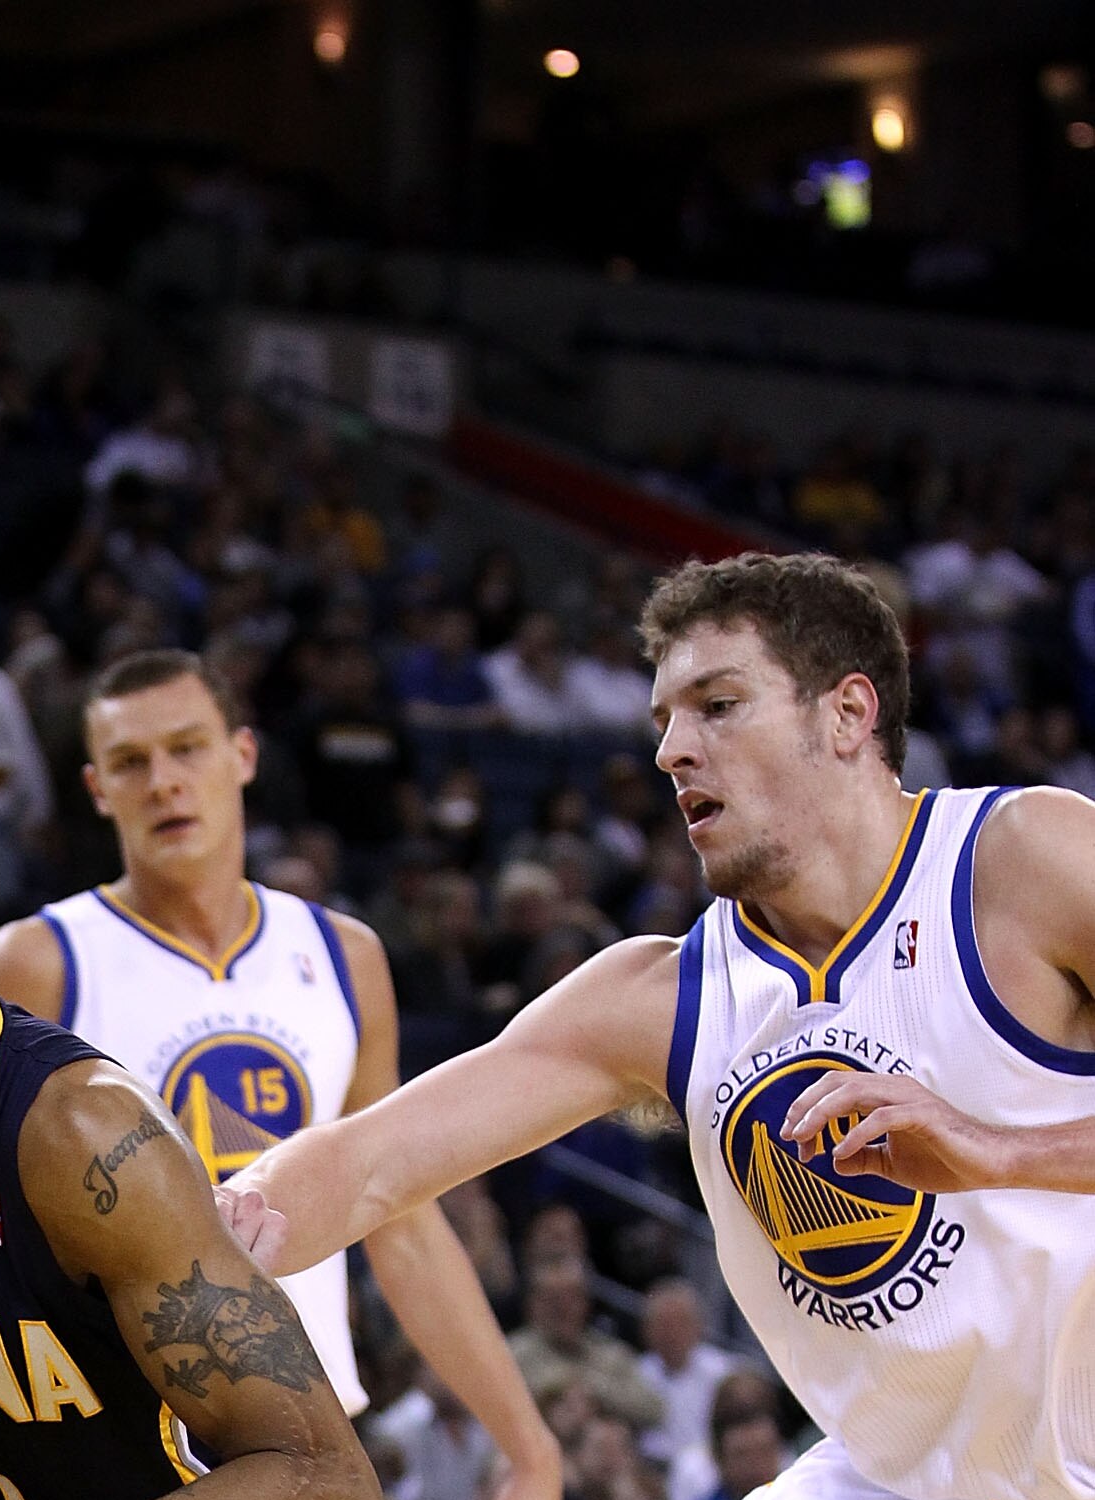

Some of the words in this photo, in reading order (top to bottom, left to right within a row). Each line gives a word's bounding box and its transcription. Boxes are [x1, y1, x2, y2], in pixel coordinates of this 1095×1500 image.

[823, 1027, 913, 1075] STATE
[239, 1067, 290, 1117] 15
[778, 1217, 966, 1332] WARRIORS
